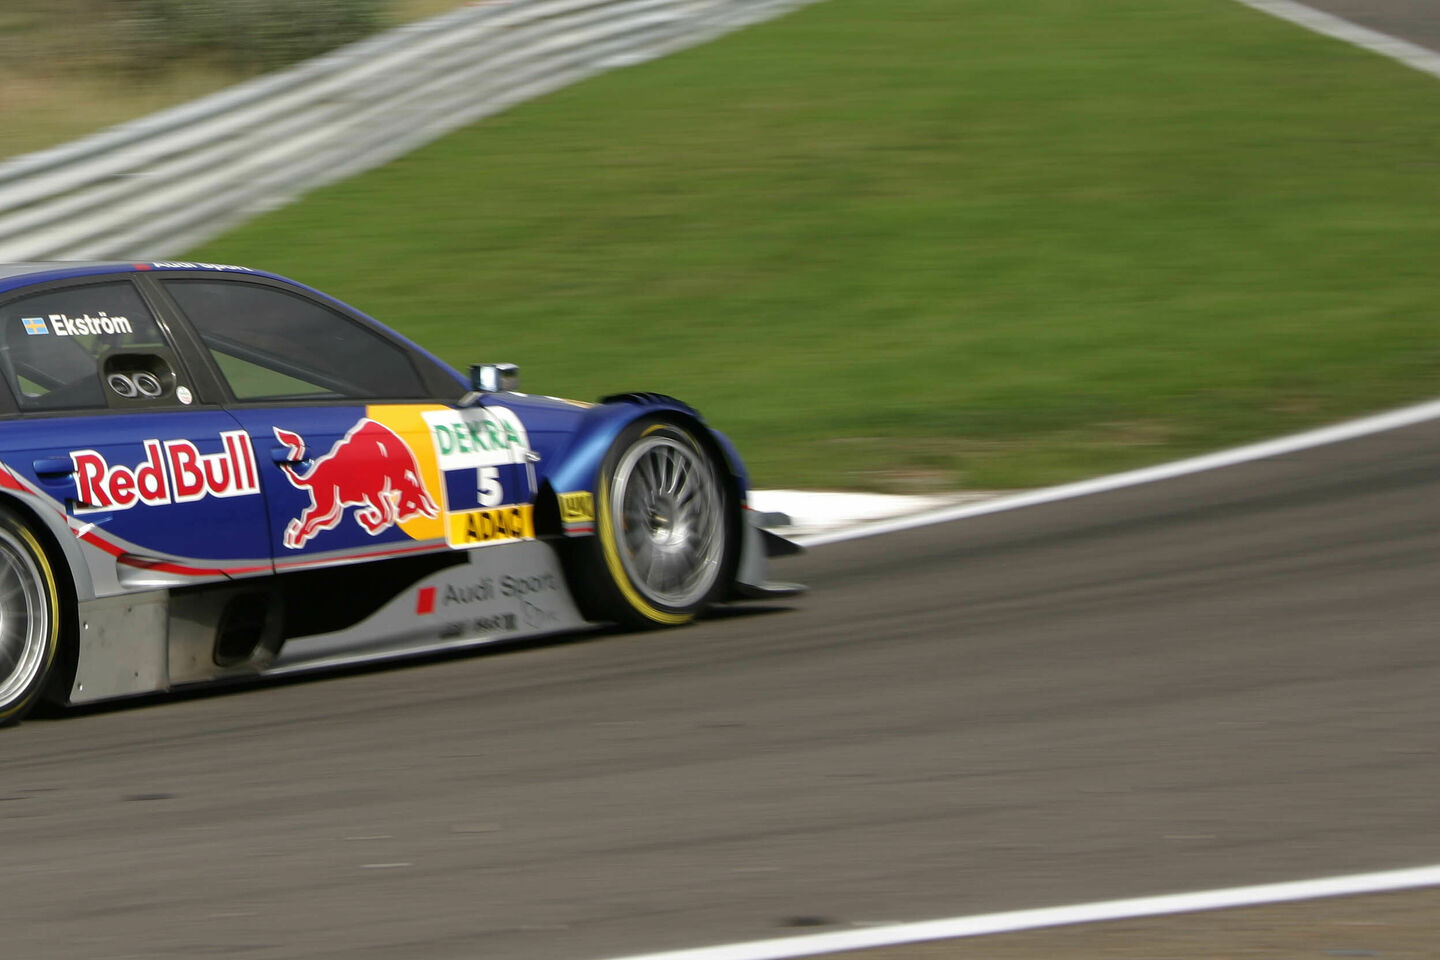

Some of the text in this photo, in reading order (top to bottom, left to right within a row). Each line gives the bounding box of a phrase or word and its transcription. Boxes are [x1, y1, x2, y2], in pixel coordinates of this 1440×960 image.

[48, 311, 133, 337] Ekström
[434, 419, 527, 455] DEKRA
[73, 433, 257, 509] Red Bull
[476, 465, 504, 508] 5
[466, 508, 524, 542] ADAC
[442, 577, 494, 606] Audi
